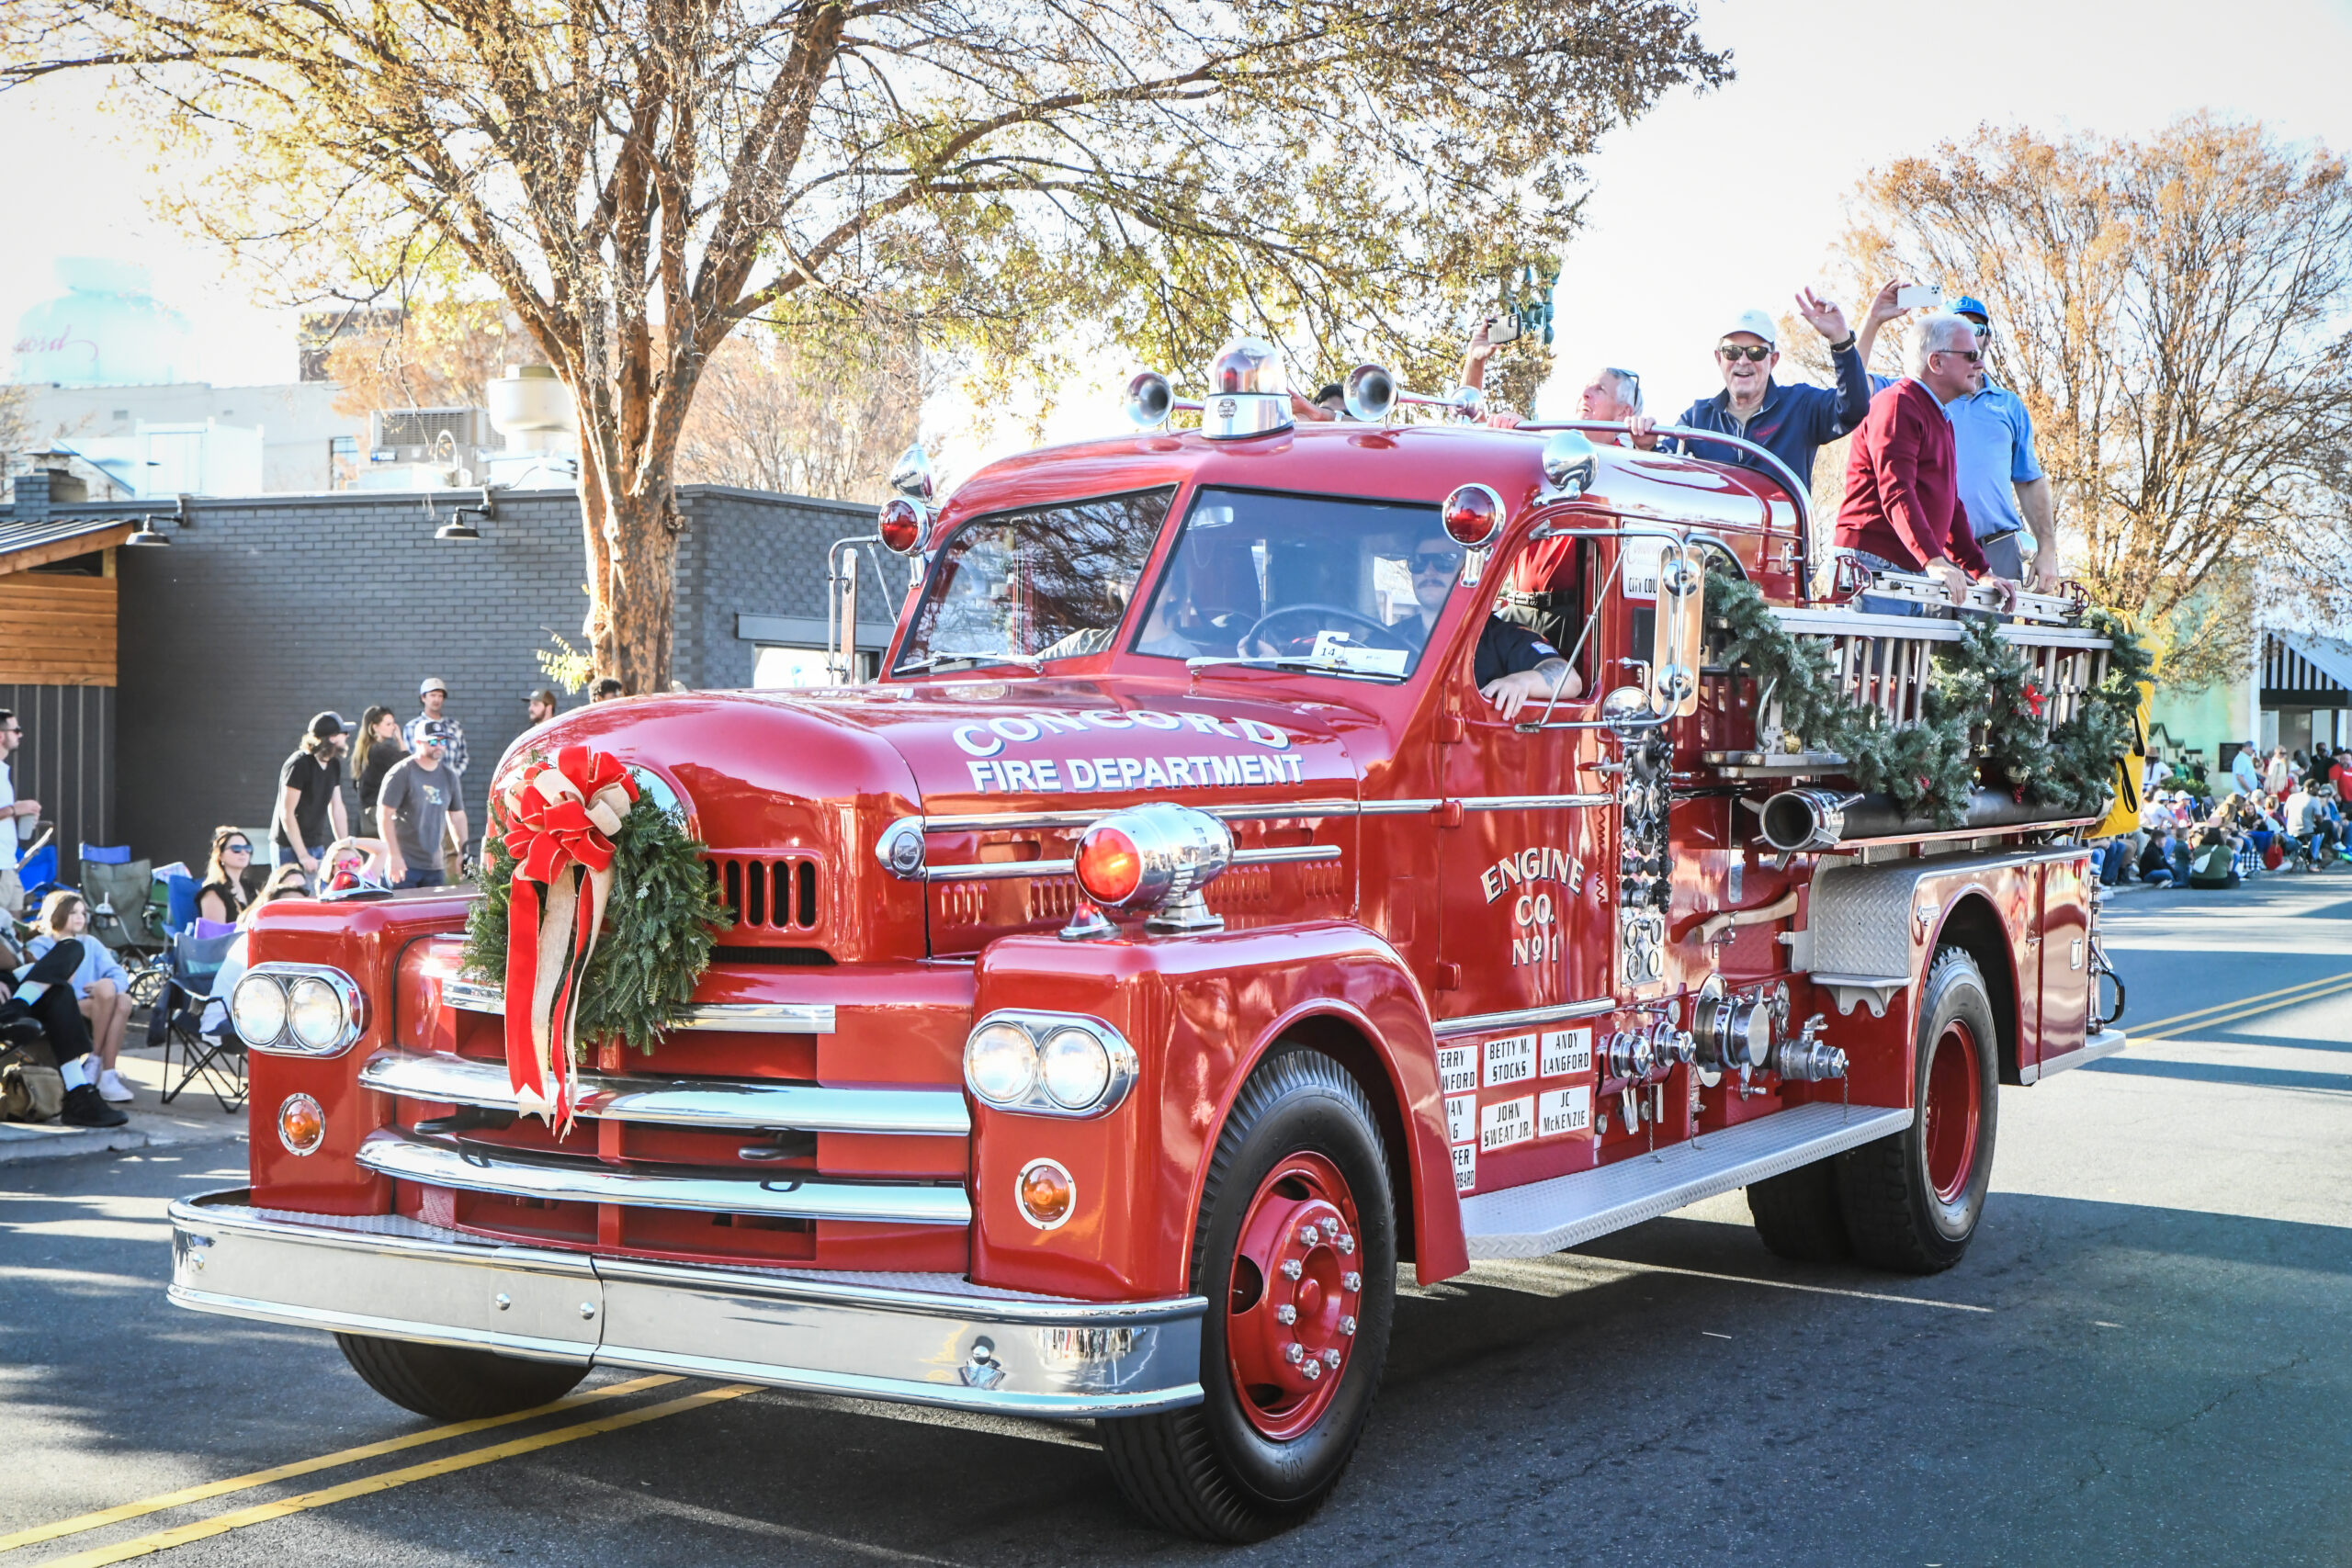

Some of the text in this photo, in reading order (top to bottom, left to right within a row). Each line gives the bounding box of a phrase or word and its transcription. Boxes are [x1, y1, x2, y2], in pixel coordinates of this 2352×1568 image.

[1644, 577, 1657, 594] COU
[1321, 647, 1335, 656] 14
[953, 709, 1291, 757] CONCORD
[967, 754, 1305, 795] FIRE DEPARTMENT
[1480, 847, 1585, 904] ENGINE
[1515, 894, 1555, 927] CO.
[1552, 933, 1558, 963] 1
[1489, 1038, 1530, 1060] BETTY M.
[1555, 1032, 1578, 1050] ANDY
[1438, 1050, 1465, 1068] ERRY
[1544, 1052, 1589, 1075] LANGFORD
[1442, 1071, 1475, 1091] WFORD
[1493, 1061, 1526, 1082] STOCKS
[1561, 1091, 1570, 1108] JC
[1497, 1102, 1520, 1122] JOHN
[1544, 1110, 1586, 1133] McKENZIE
[1485, 1121, 1532, 1147] SWEAT JR.
[1453, 1148, 1469, 1166] FER
